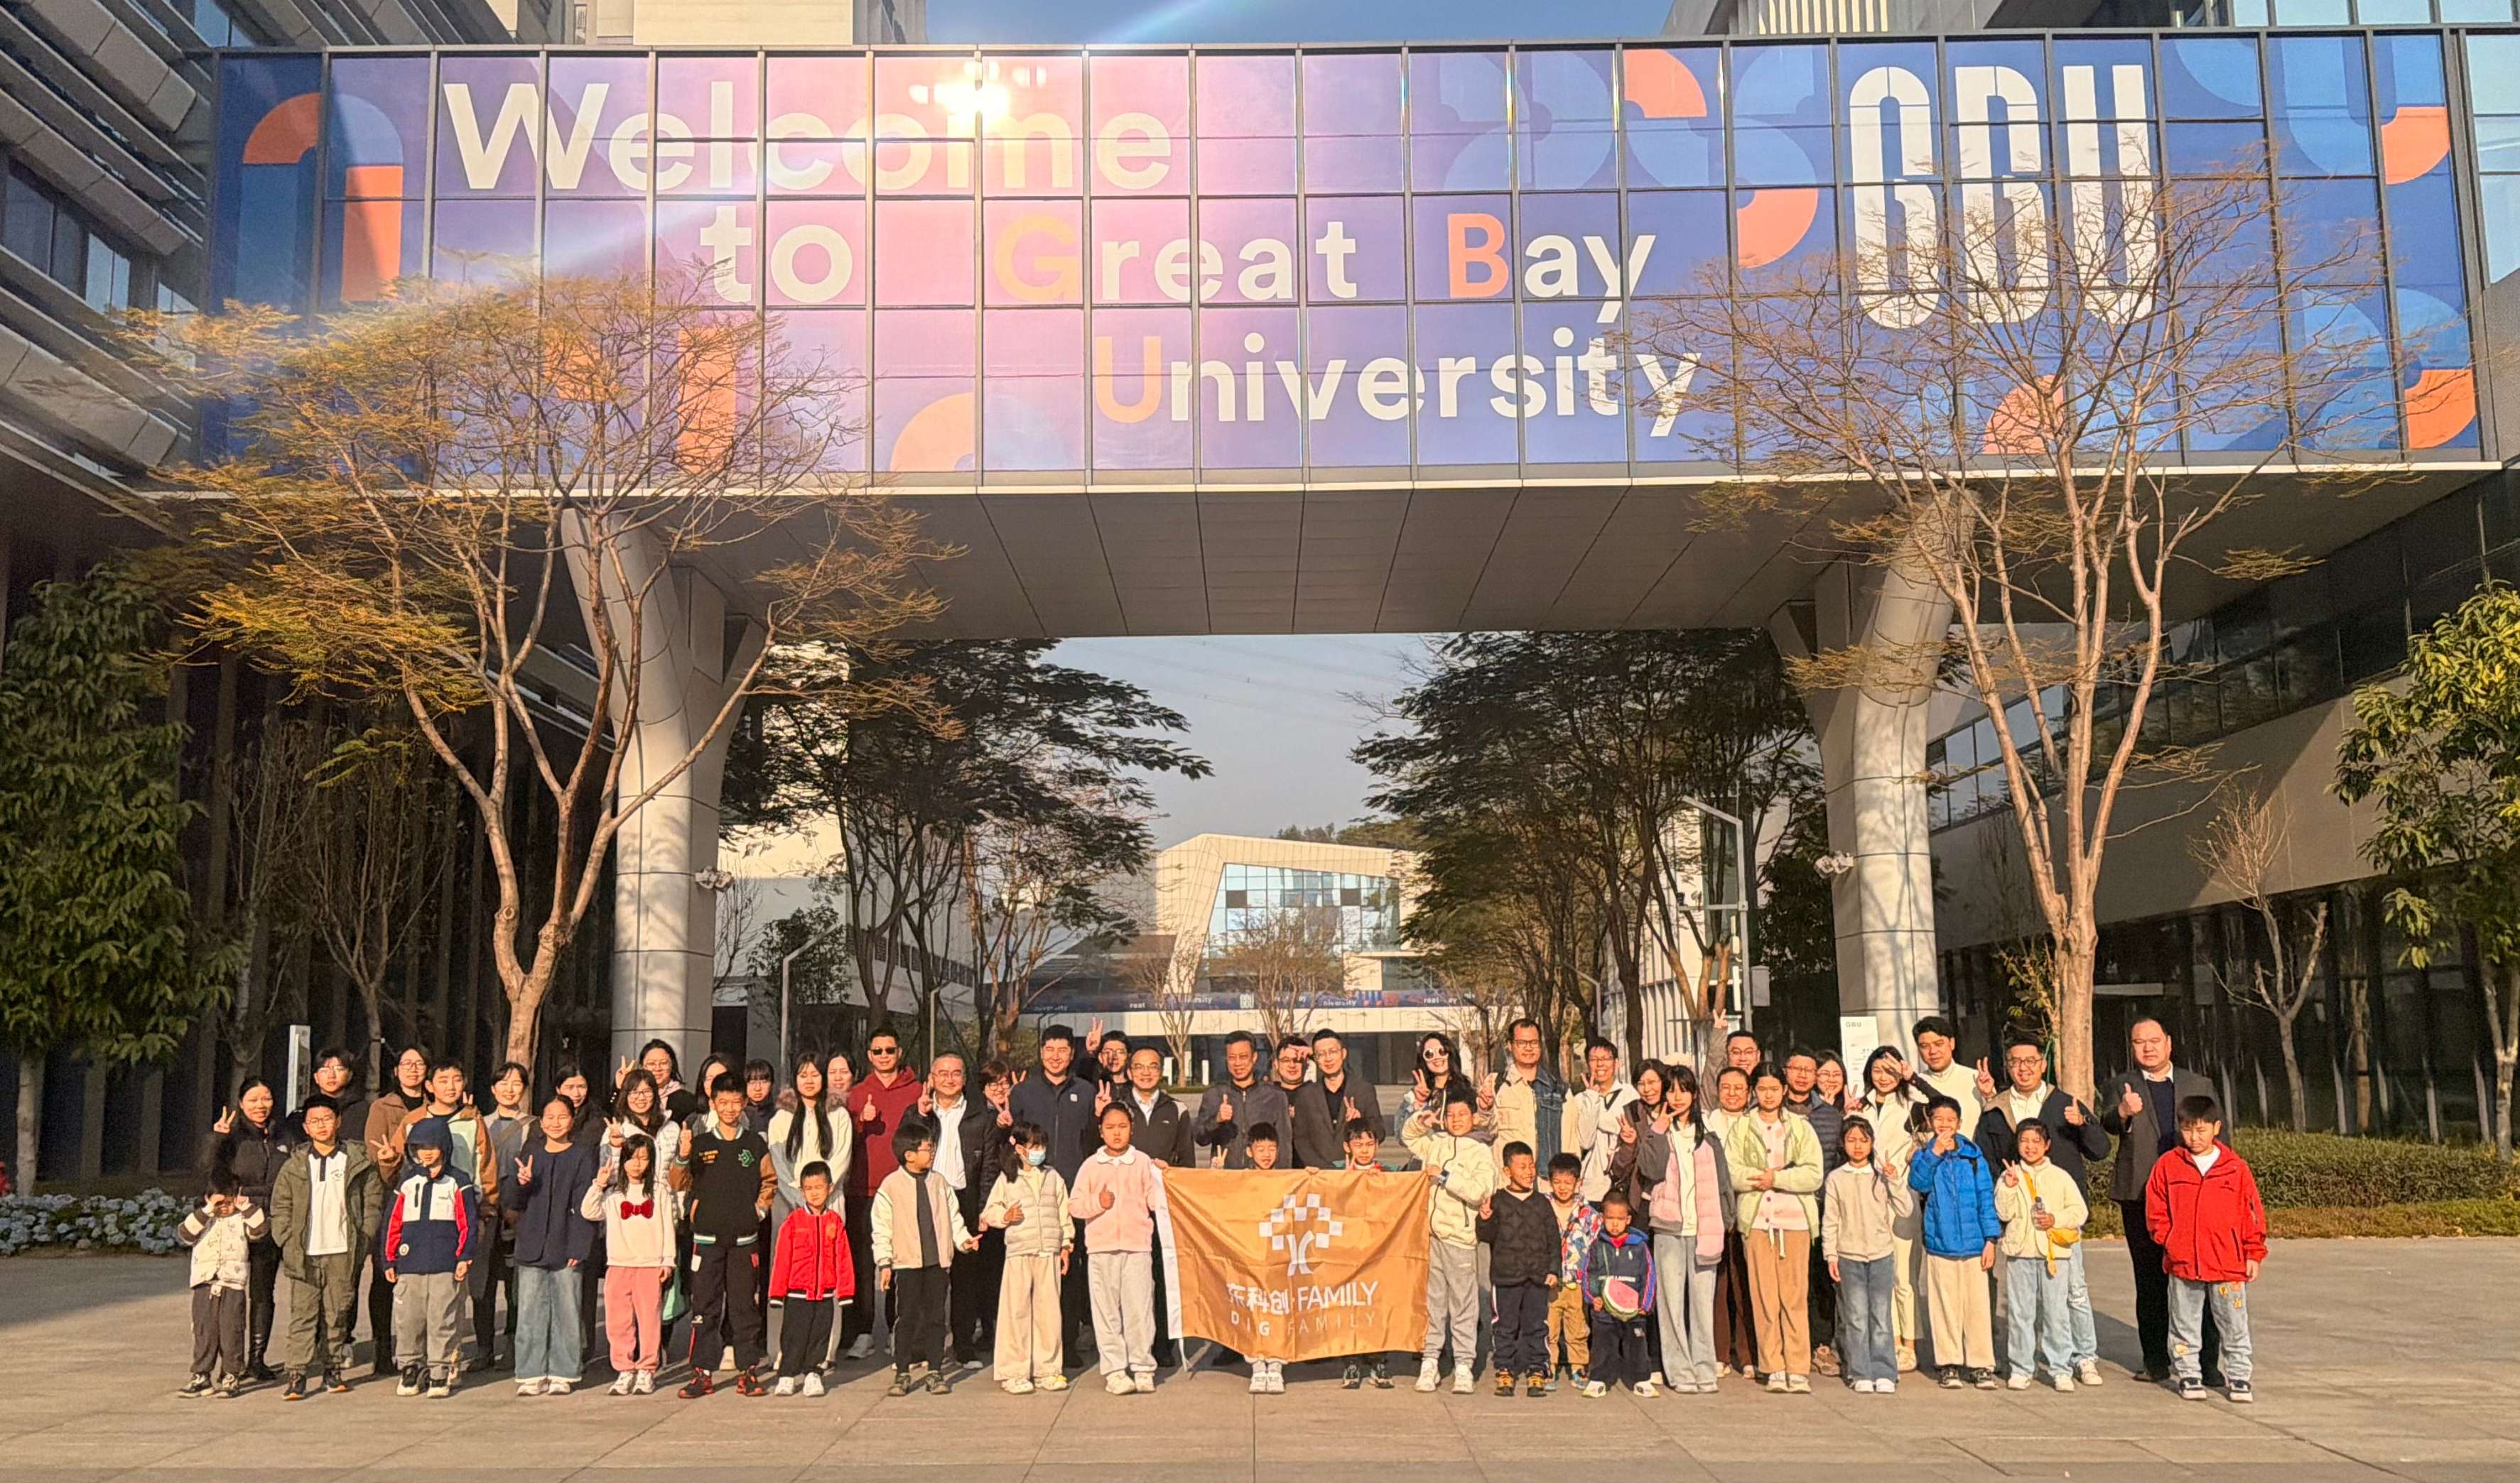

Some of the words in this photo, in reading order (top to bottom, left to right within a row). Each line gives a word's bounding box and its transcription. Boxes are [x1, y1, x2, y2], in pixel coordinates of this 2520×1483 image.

[443, 82, 1172, 191] Welcome
[700, 205, 853, 303] to
[993, 214, 1358, 302] Great
[1447, 212, 1655, 323] Bay
[1094, 327, 1702, 438] University
[1287, 1312, 1375, 1335] FAMILY
[1297, 1281, 1378, 1312] FAMILY
